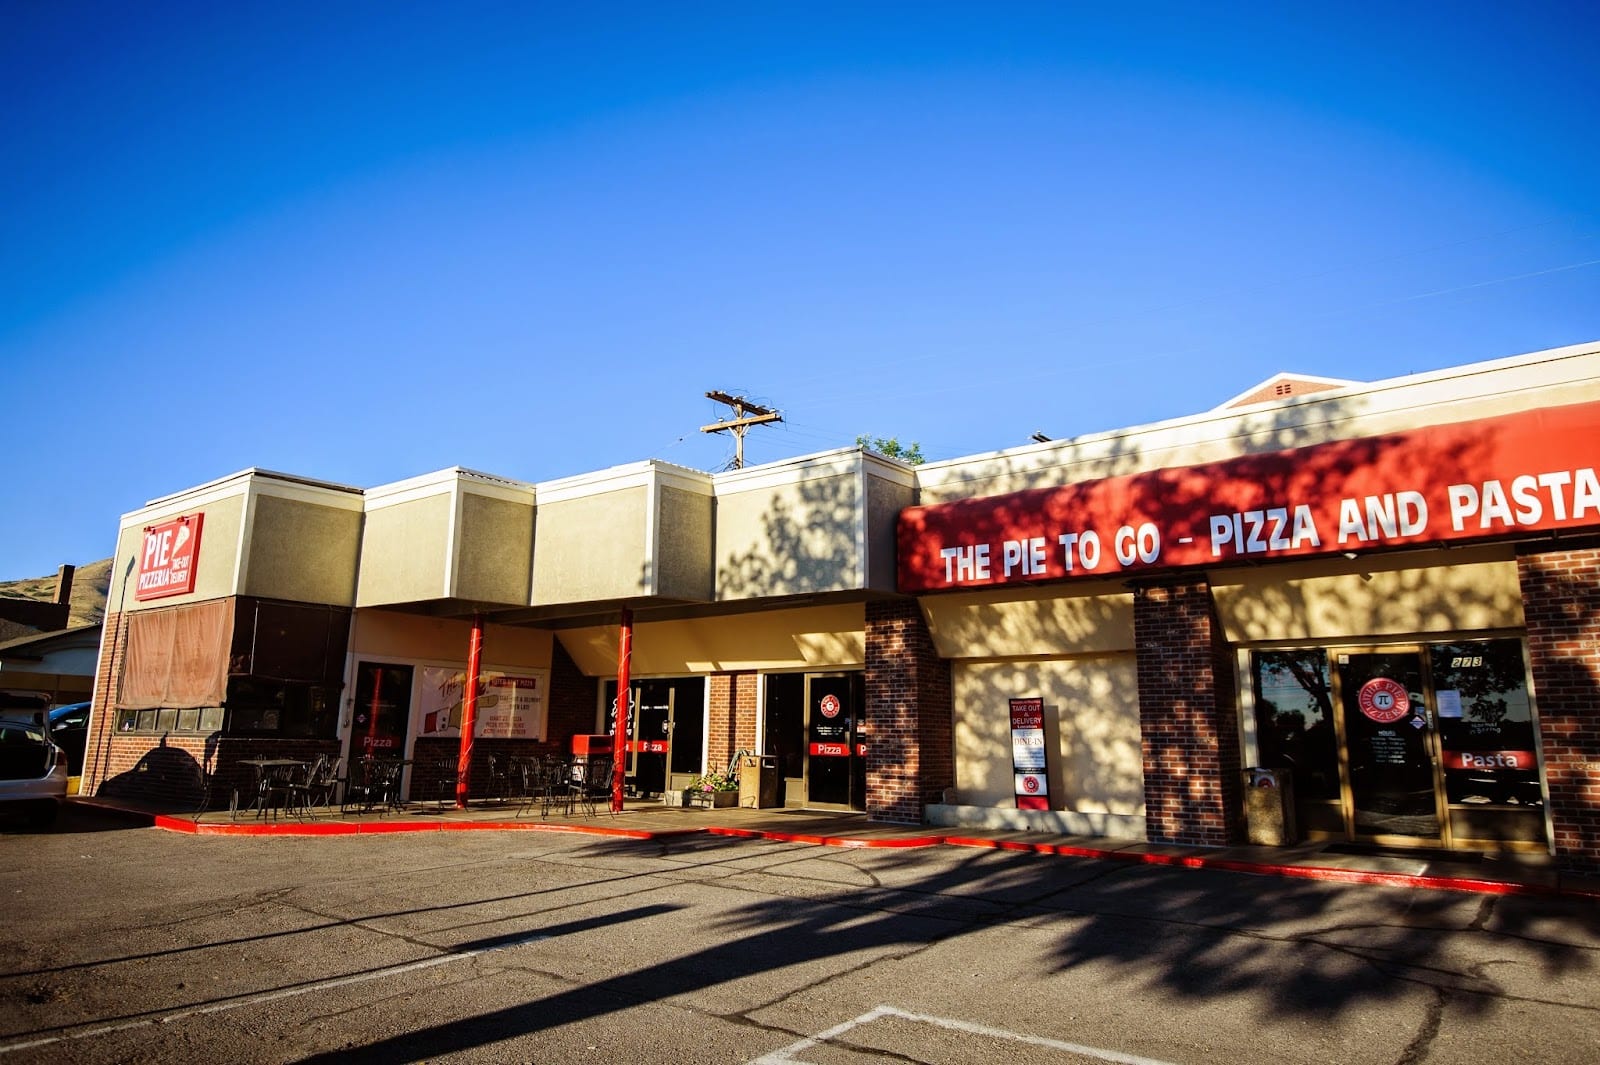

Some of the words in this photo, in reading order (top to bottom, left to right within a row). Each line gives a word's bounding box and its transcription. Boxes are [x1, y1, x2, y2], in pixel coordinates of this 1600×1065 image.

[940, 544, 990, 582] THE
[1003, 536, 1047, 577] PIE
[1059, 530, 1100, 571] TO
[1115, 522, 1160, 566] GO
[1209, 504, 1321, 557] PIZZA
[1338, 491, 1428, 544] AND
[1447, 468, 1600, 532] PASTA
[143, 530, 172, 570] PIE
[138, 568, 170, 590] PIZZERIA
[1452, 657, 1481, 667] 273
[1362, 682, 1381, 701] THE
[1385, 682, 1403, 698] PIE
[1362, 698, 1406, 720] PIZZERIA
[1012, 717, 1042, 725] DELIVERY
[364, 736, 392, 747] Pizza
[818, 744, 842, 755] Pizza
[1461, 752, 1518, 768] Pasta
